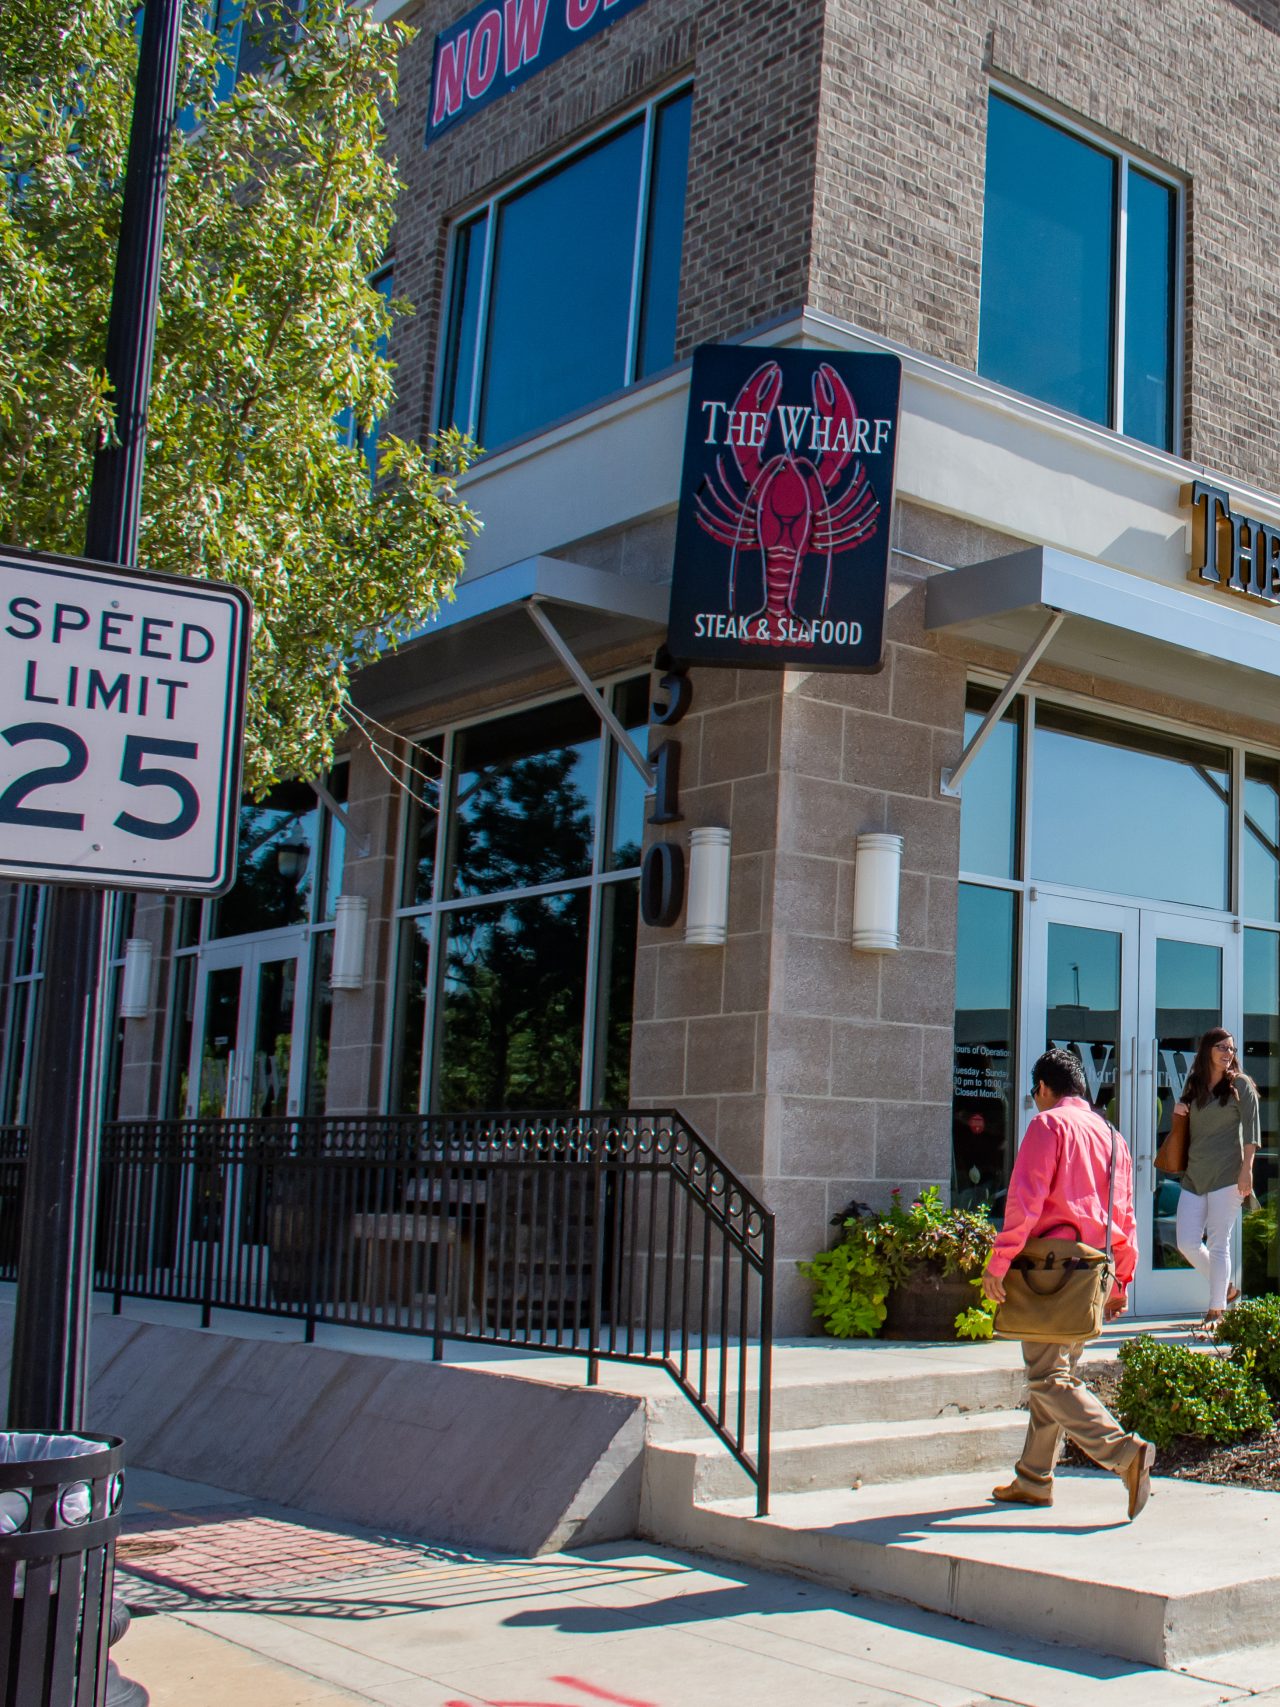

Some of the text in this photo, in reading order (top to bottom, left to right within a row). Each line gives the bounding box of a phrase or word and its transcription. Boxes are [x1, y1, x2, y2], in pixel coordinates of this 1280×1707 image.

[432, 0, 550, 127] NOW
[702, 401, 891, 454] THE WHARF
[5, 597, 215, 664] SPEED
[695, 613, 863, 645] STEAK & SEAFOOD
[24, 660, 189, 720] LIMIT
[0, 721, 200, 840] 25
[971, 1045, 979, 1055] of
[954, 1087, 978, 1097] Closed
[975, 1079, 982, 1087] to
[985, 1068, 1009, 1080] Sunday
